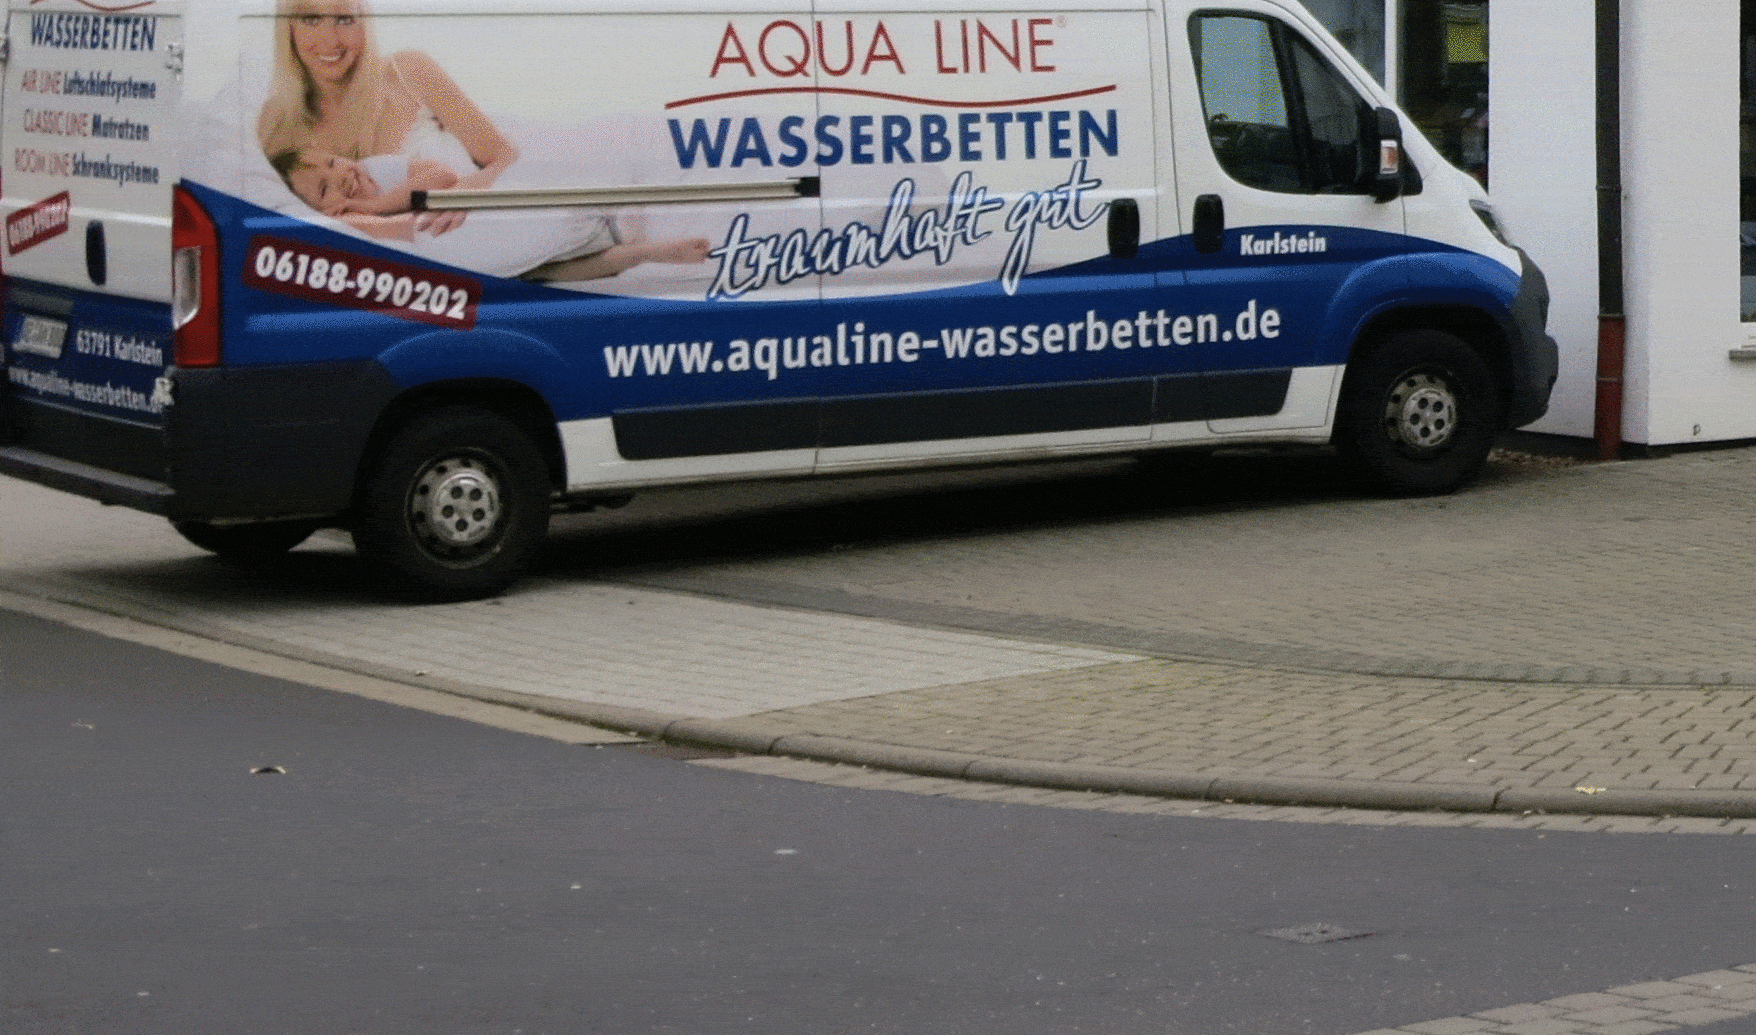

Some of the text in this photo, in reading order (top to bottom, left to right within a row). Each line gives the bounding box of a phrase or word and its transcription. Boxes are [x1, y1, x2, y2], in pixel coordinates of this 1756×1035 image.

[31, 14, 157, 51] WASSERBETTEN
[709, 19, 907, 79] AQUA
[92, 113, 150, 141] Matratzen
[666, 109, 1119, 170] WASSERBETTEN
[706, 159, 1110, 301] traumhaft gut
[1239, 230, 1327, 256] Karlstein
[254, 245, 469, 320] 06188-990202
[77, 330, 111, 358] 63791
[114, 335, 163, 368] Karlstein
[603, 298, 1282, 381] www.aqualine-wasserbetten.de
